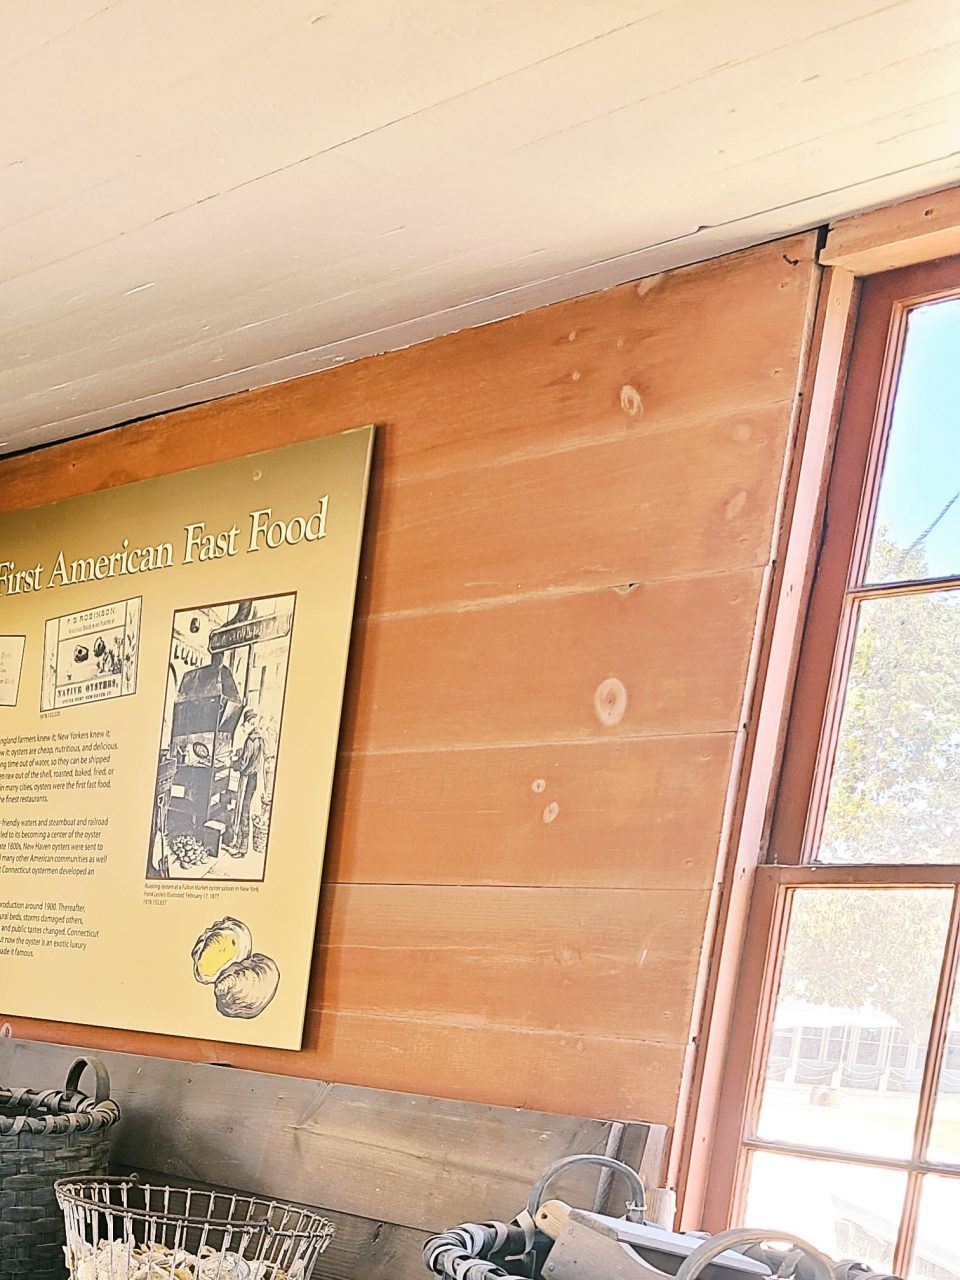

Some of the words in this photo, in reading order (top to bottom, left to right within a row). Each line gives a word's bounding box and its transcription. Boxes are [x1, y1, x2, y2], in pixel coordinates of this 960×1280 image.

[45, 538, 174, 589] American
[181, 522, 240, 565] Fast
[246, 494, 330, 553] Food
[57, 686, 82, 698] NATIVE
[70, 732, 89, 740] Yorkers
[11, 748, 28, 757] oysters
[88, 756, 111, 765] shipped
[34, 783, 52, 792] oysters
[88, 818, 109, 826] railroad
[21, 831, 46, 840] becoming
[84, 831, 101, 840] oyster
[51, 843, 70, 852] oysters
[54, 855, 88, 863] communities
[1, 866, 31, 874] Connecticut
[32, 867, 58, 876] oystermen
[59, 867, 87, 877] developed
[23, 914, 40, 922] storms
[40, 915, 65, 925] damaged
[11, 925, 27, 934] public
[27, 926, 42, 934] tastes
[67, 928, 99, 937] Connecticut
[25, 938, 41, 947] oyster
[54, 940, 69, 948] exotic
[70, 941, 87, 951] luxury
